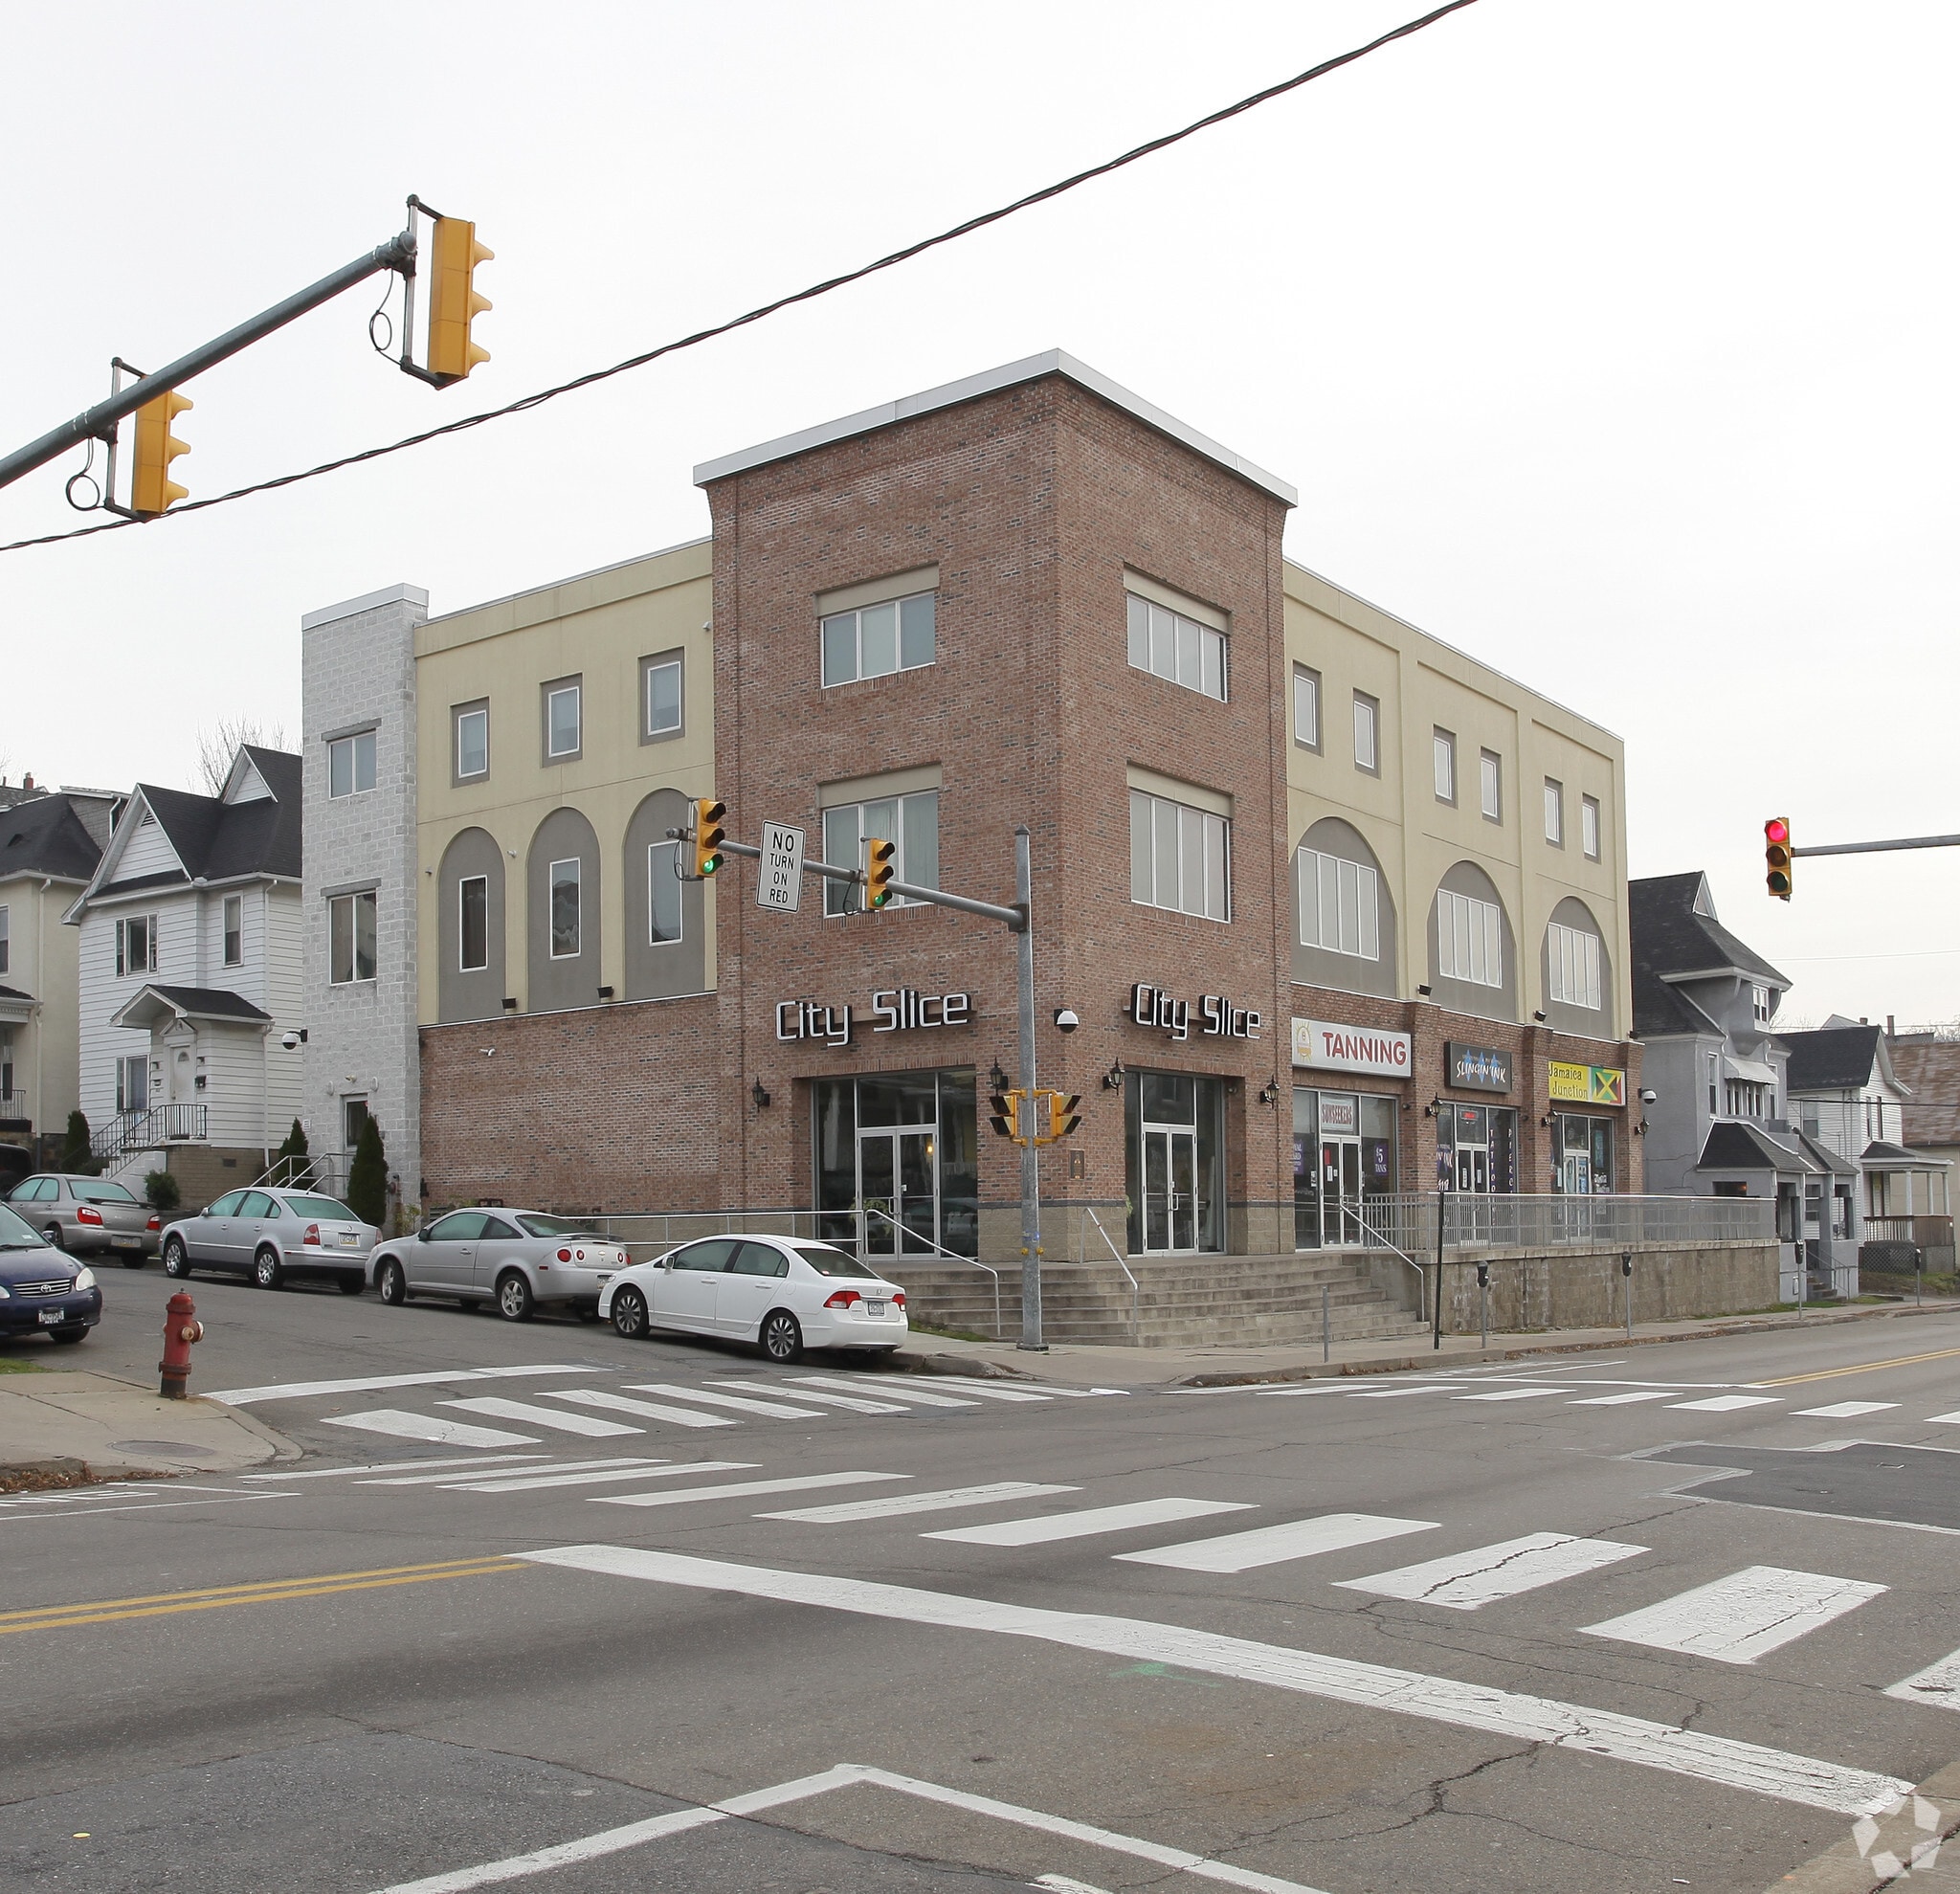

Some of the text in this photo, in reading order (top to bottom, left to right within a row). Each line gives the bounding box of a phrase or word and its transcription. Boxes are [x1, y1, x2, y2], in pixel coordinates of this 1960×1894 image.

[773, 831, 794, 852] NO
[769, 853, 794, 870] TURN
[773, 871, 788, 886] ON
[769, 888, 789, 903] RED
[775, 989, 969, 1047] City Slice
[1133, 984, 1261, 1040] City Slice
[1322, 1031, 1407, 1066] TANNING
[1548, 1062, 1582, 1081] Jamaica
[1552, 1081, 1589, 1100] Junction
